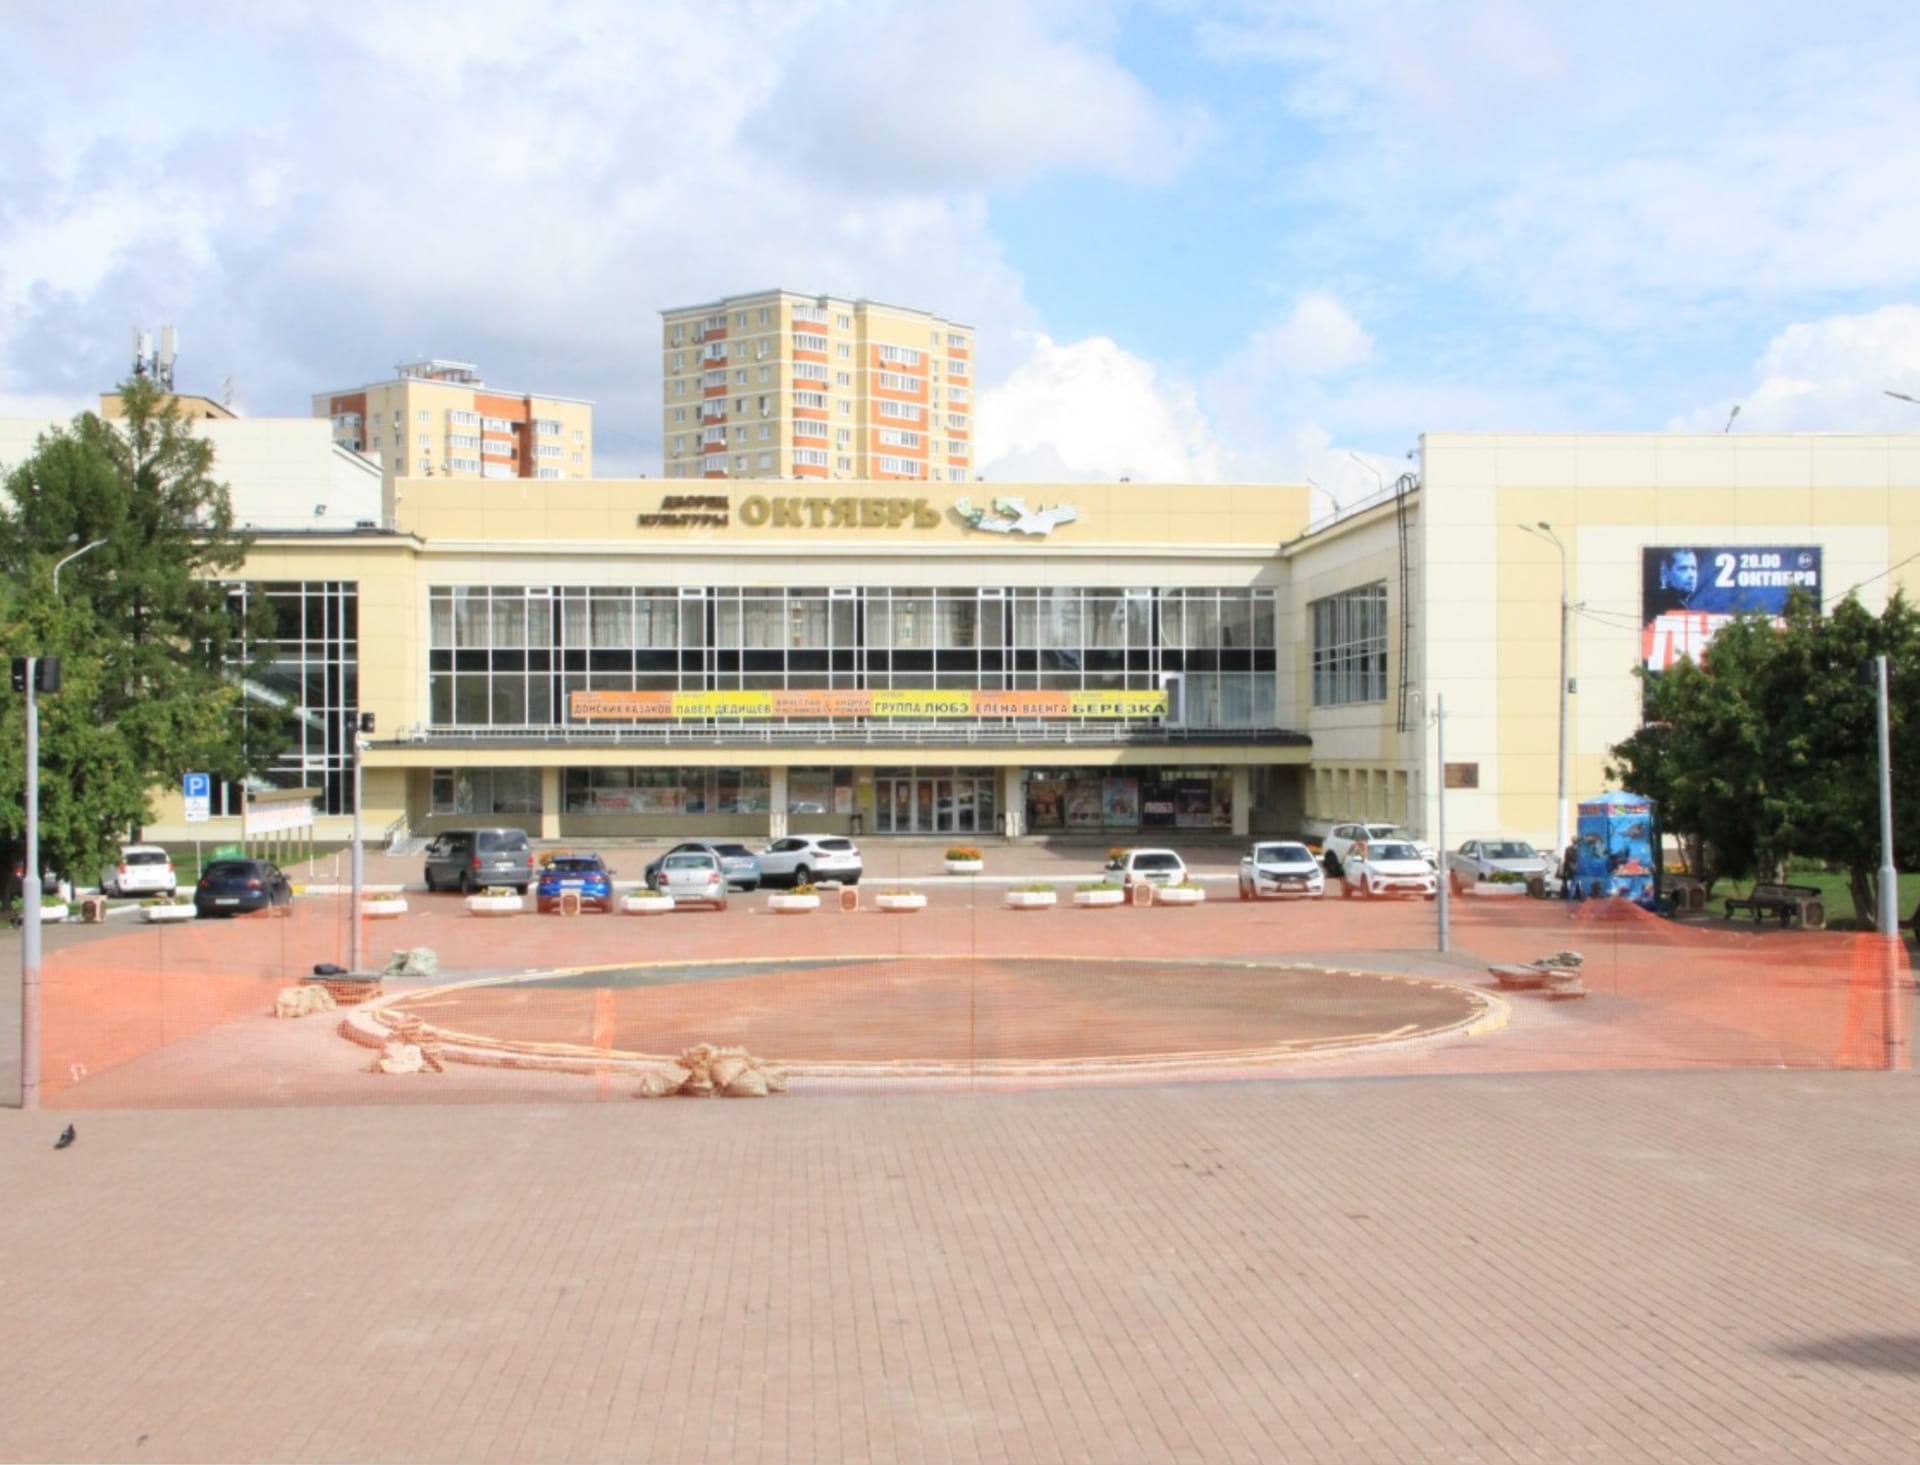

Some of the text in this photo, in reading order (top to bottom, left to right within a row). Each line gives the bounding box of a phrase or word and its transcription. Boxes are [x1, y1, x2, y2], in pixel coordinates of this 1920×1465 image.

[739, 495, 942, 529] ОКТЯБРЬ
[1740, 554, 1781, 568] 20.00
[1715, 553, 1736, 587] 2
[875, 702, 920, 712] ГРУППА
[925, 702, 969, 712] ЛЮБЭ
[975, 703, 1067, 713] ЕЛЕНА ВАЕНГА
